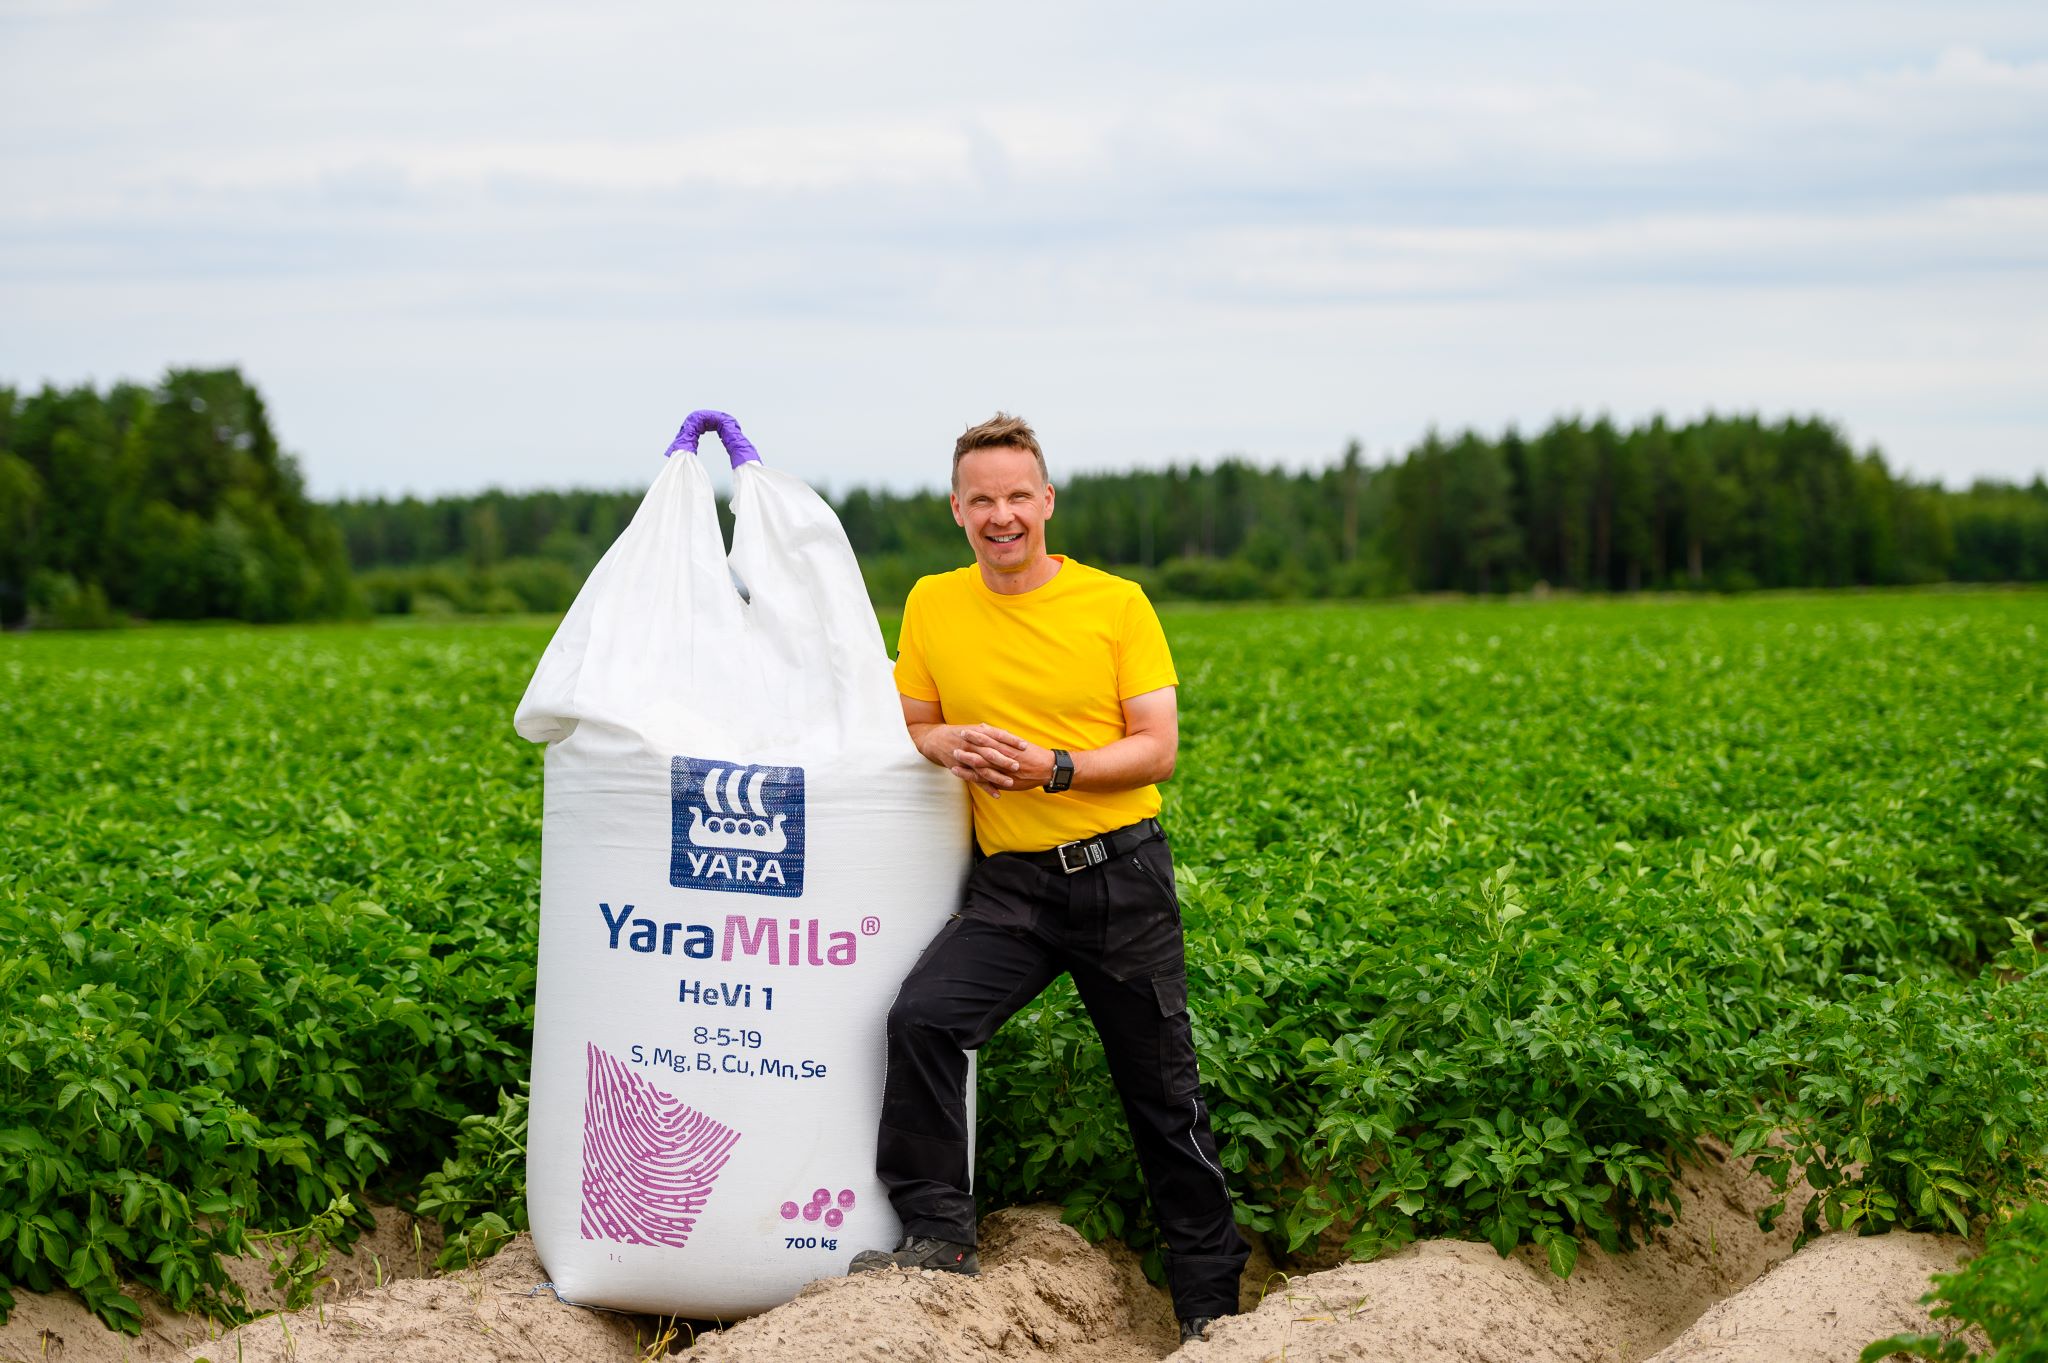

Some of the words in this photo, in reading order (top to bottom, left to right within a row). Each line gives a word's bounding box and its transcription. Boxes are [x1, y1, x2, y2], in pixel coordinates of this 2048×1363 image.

[687, 851, 786, 885] YARA
[679, 979, 751, 1008] HeVi
[762, 987, 773, 1010] 1
[693, 1026, 762, 1049] 8-5-19
[631, 1045, 648, 1066] S,
[653, 1048, 691, 1073] Mg,
[696, 1053, 717, 1074] B,
[722, 1054, 754, 1077] Cu,
[785, 1237, 817, 1249] 700
[821, 1236, 838, 1251] kg
